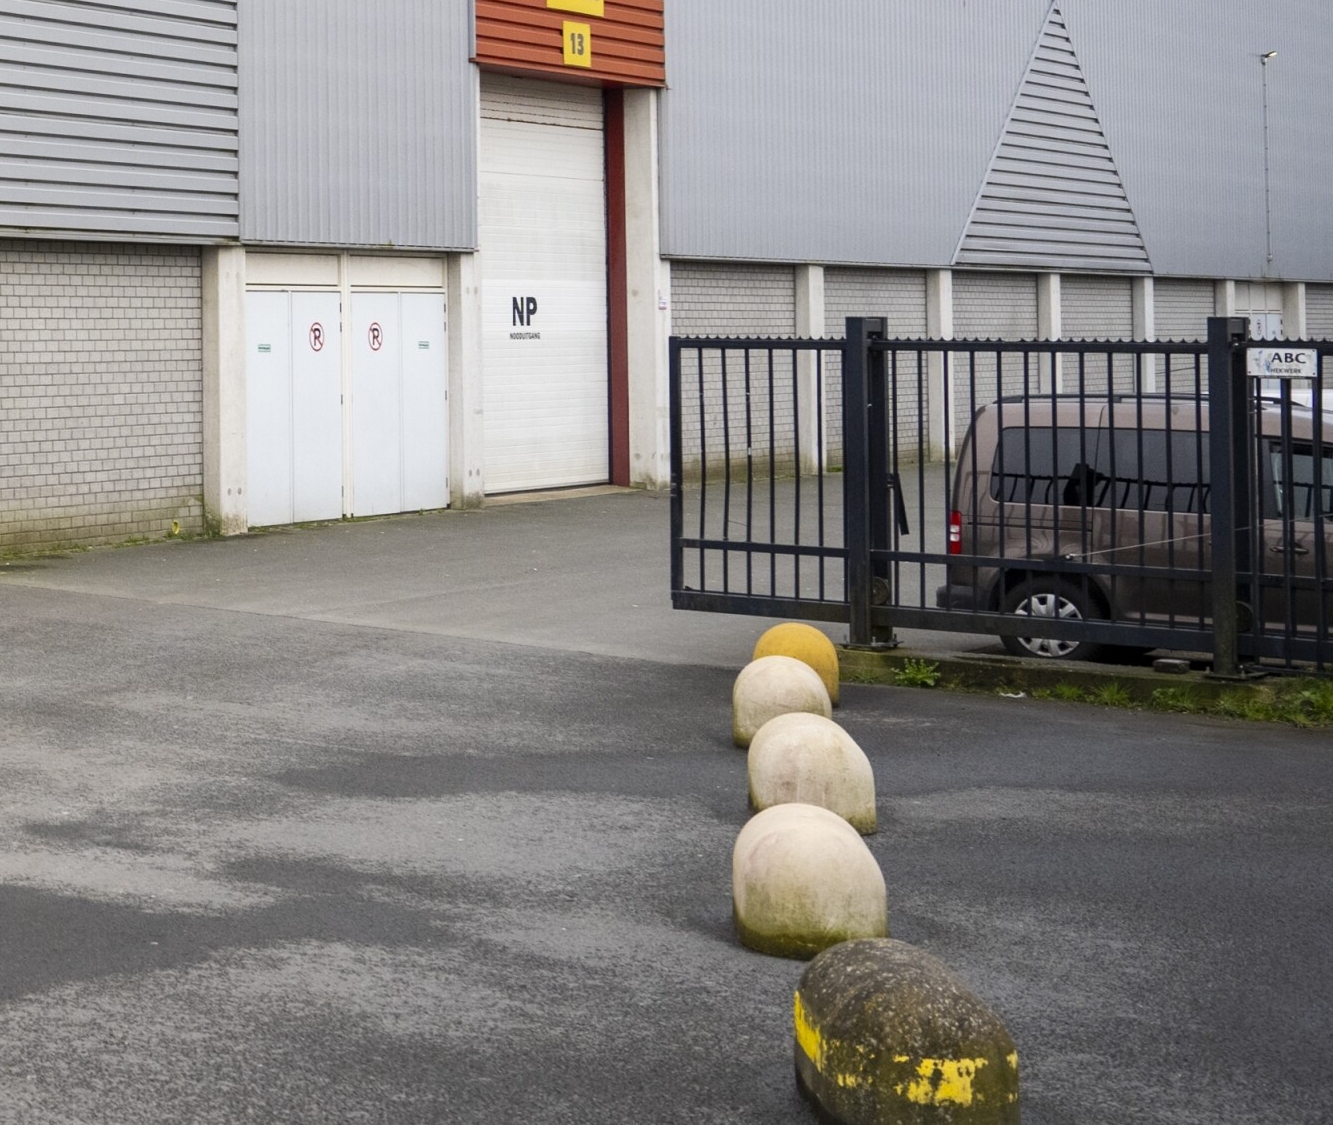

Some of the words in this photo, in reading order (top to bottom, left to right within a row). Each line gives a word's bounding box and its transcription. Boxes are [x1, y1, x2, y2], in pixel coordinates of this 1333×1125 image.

[570, 32, 584, 55] 13
[512, 296, 537, 326] NP
[1271, 352, 1306, 364] ABC
